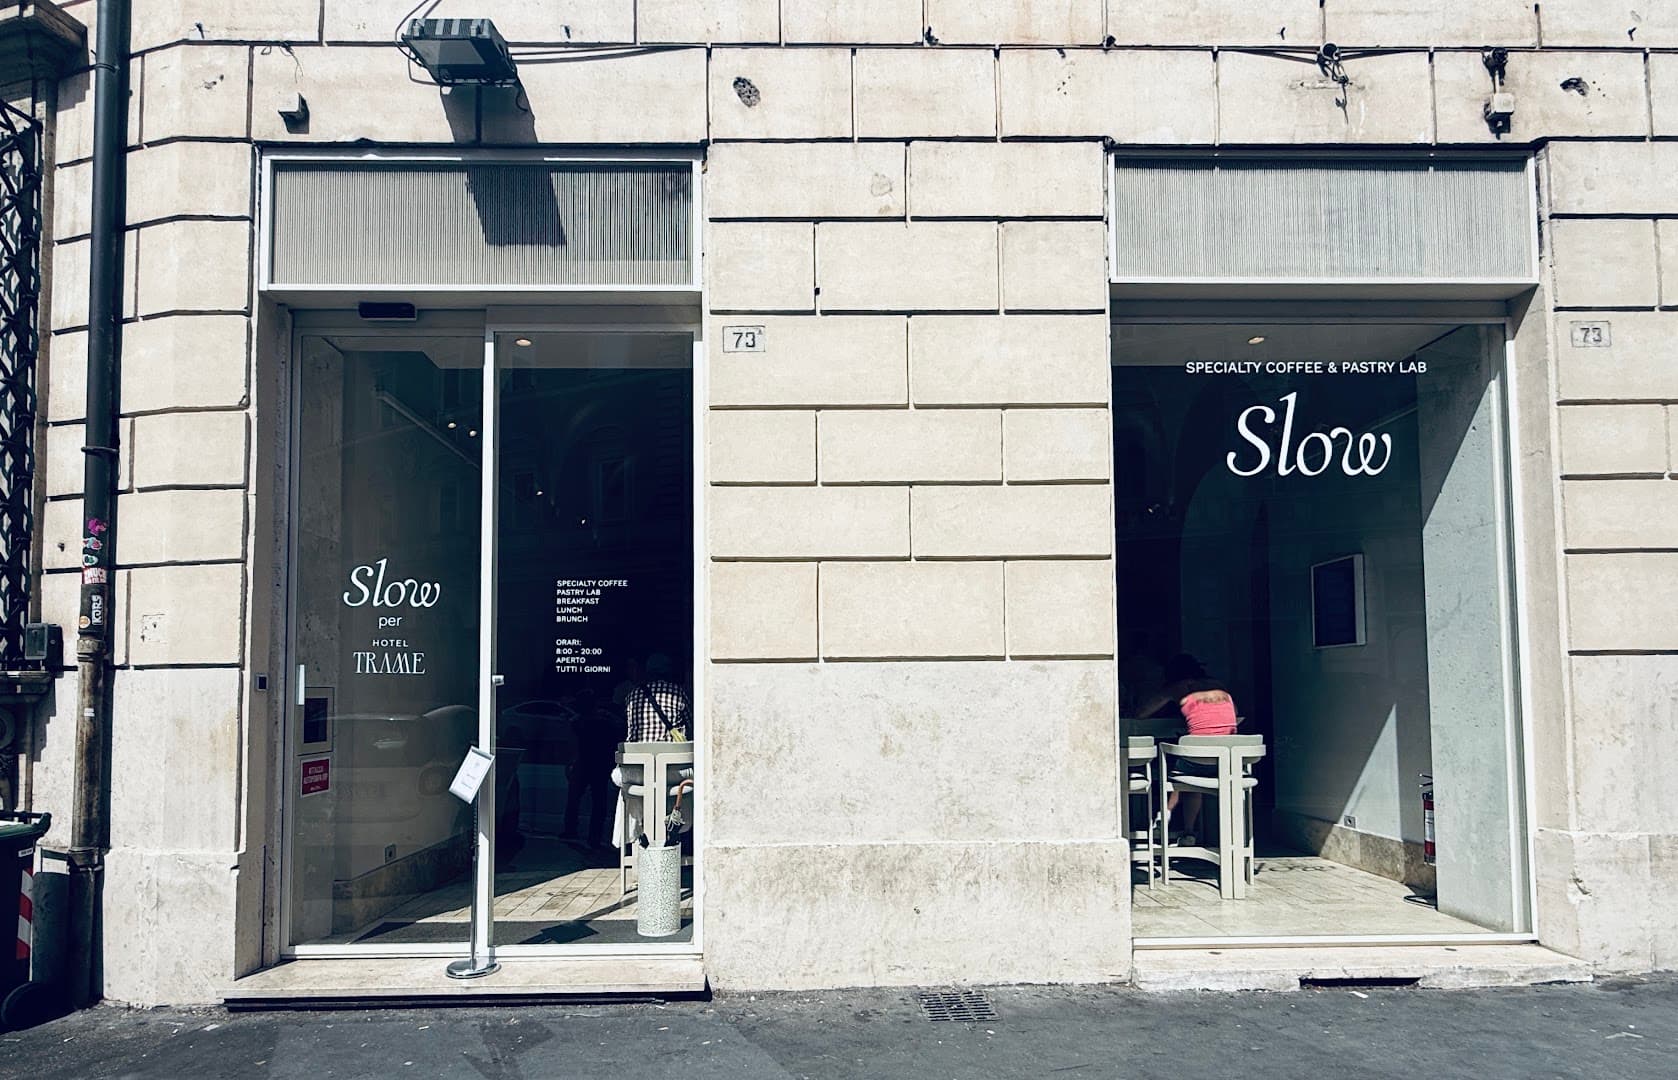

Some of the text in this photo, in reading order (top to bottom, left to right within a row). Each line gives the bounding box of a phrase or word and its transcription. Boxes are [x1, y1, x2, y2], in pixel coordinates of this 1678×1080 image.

[1580, 327, 1602, 343] 73
[1186, 361, 1427, 374] SPECIALTY COFFEE & PASTRY LAB
[1226, 391, 1392, 477] Slow
[343, 558, 441, 607] Slow
[556, 579, 628, 587] SPECIALTY COFFEE
[556, 588, 601, 596] PASTRY LAB
[556, 597, 600, 605] BREAKFAST
[556, 606, 583, 614] LUNCH
[379, 616, 402, 629] per
[556, 615, 588, 623] BRUNCH
[372, 639, 409, 647] HOTEL
[556, 638, 582, 646] ORARI:
[555, 647, 573, 655] 8:00
[580, 647, 603, 655] 20:00
[353, 651, 426, 675] TRAME
[555, 656, 586, 664] APERTO
[555, 665, 578, 673] TUTTI
[584, 665, 611, 673] GIORNI
